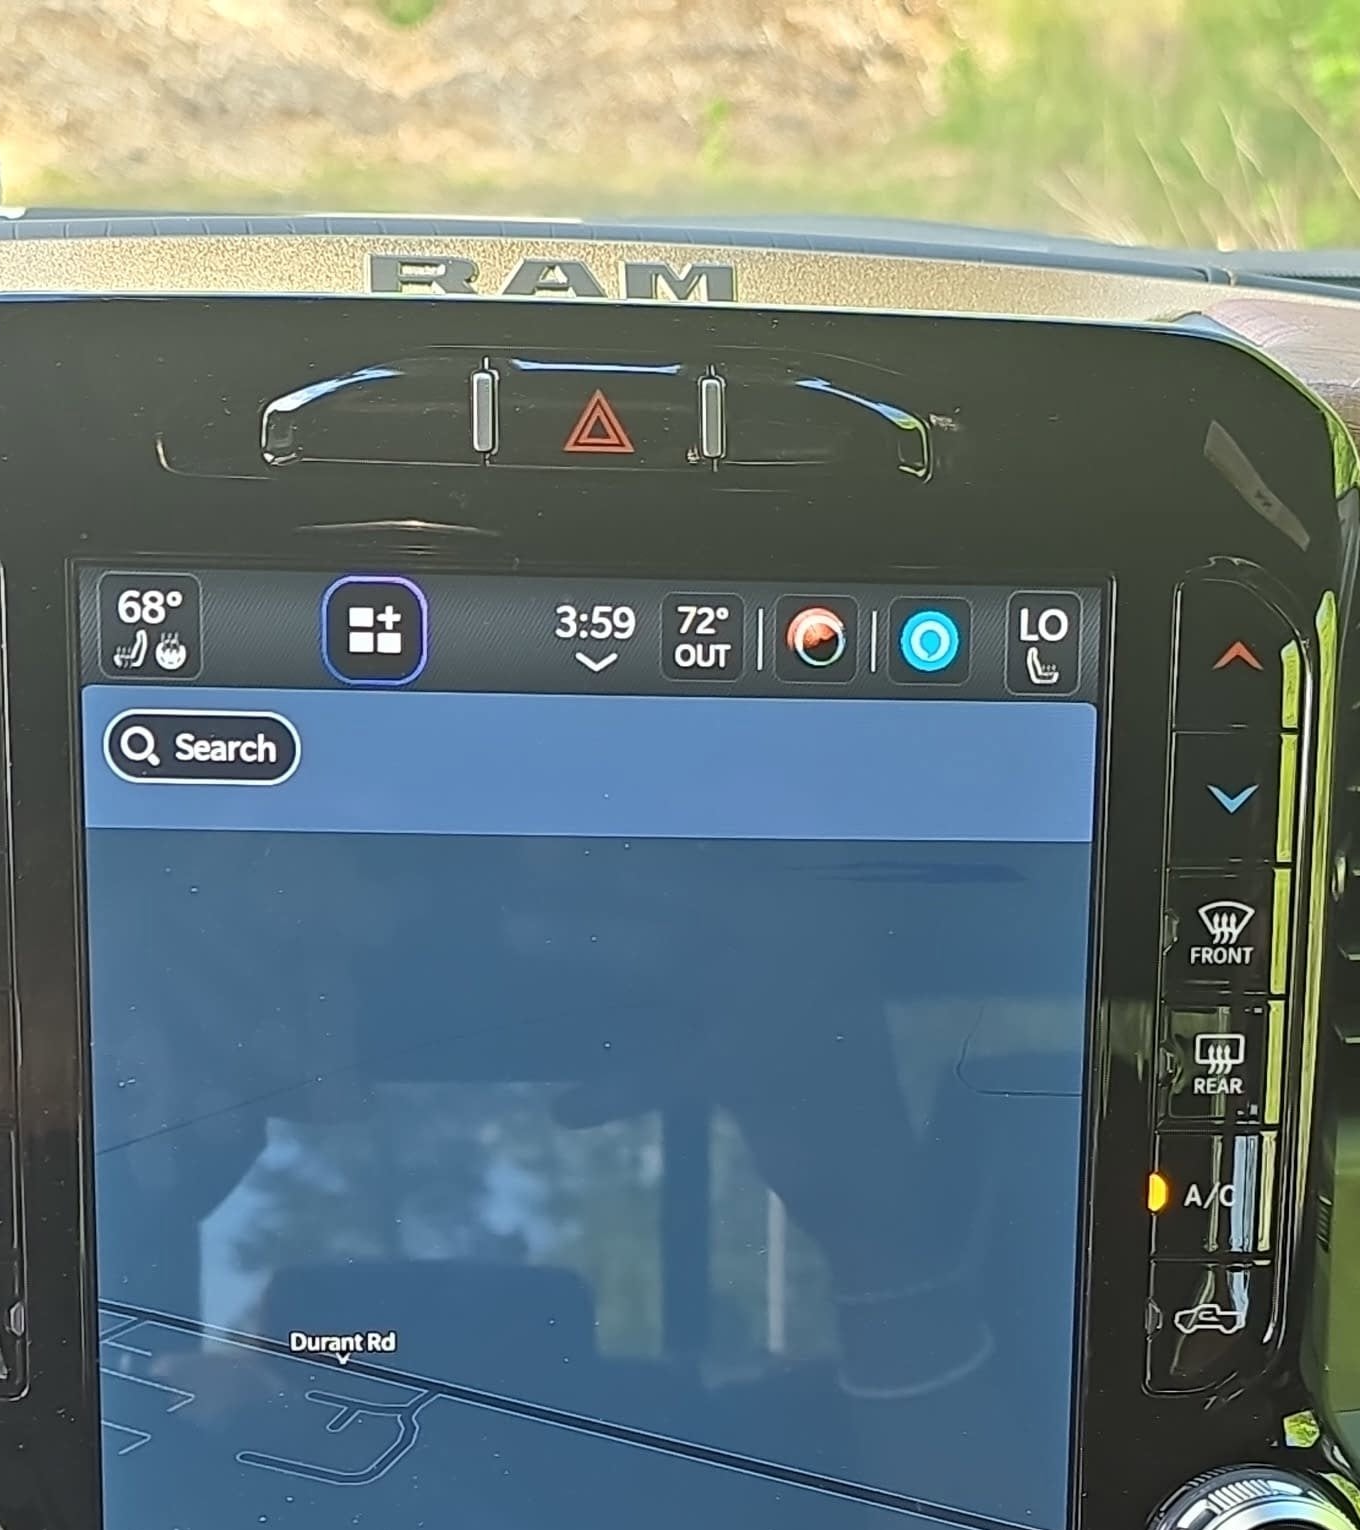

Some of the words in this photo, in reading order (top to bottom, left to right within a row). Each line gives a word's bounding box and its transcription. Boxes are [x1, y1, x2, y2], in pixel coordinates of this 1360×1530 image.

[369, 253, 737, 301] RAM
[555, 605, 636, 639] 3:59
[1020, 607, 1068, 641] LO
[674, 643, 731, 668] OUT
[175, 732, 277, 763] Search
[1190, 947, 1254, 965] FRONT
[1194, 1078, 1243, 1094] REAR
[290, 1332, 364, 1351] Durant
[367, 1332, 396, 1352] Rd
